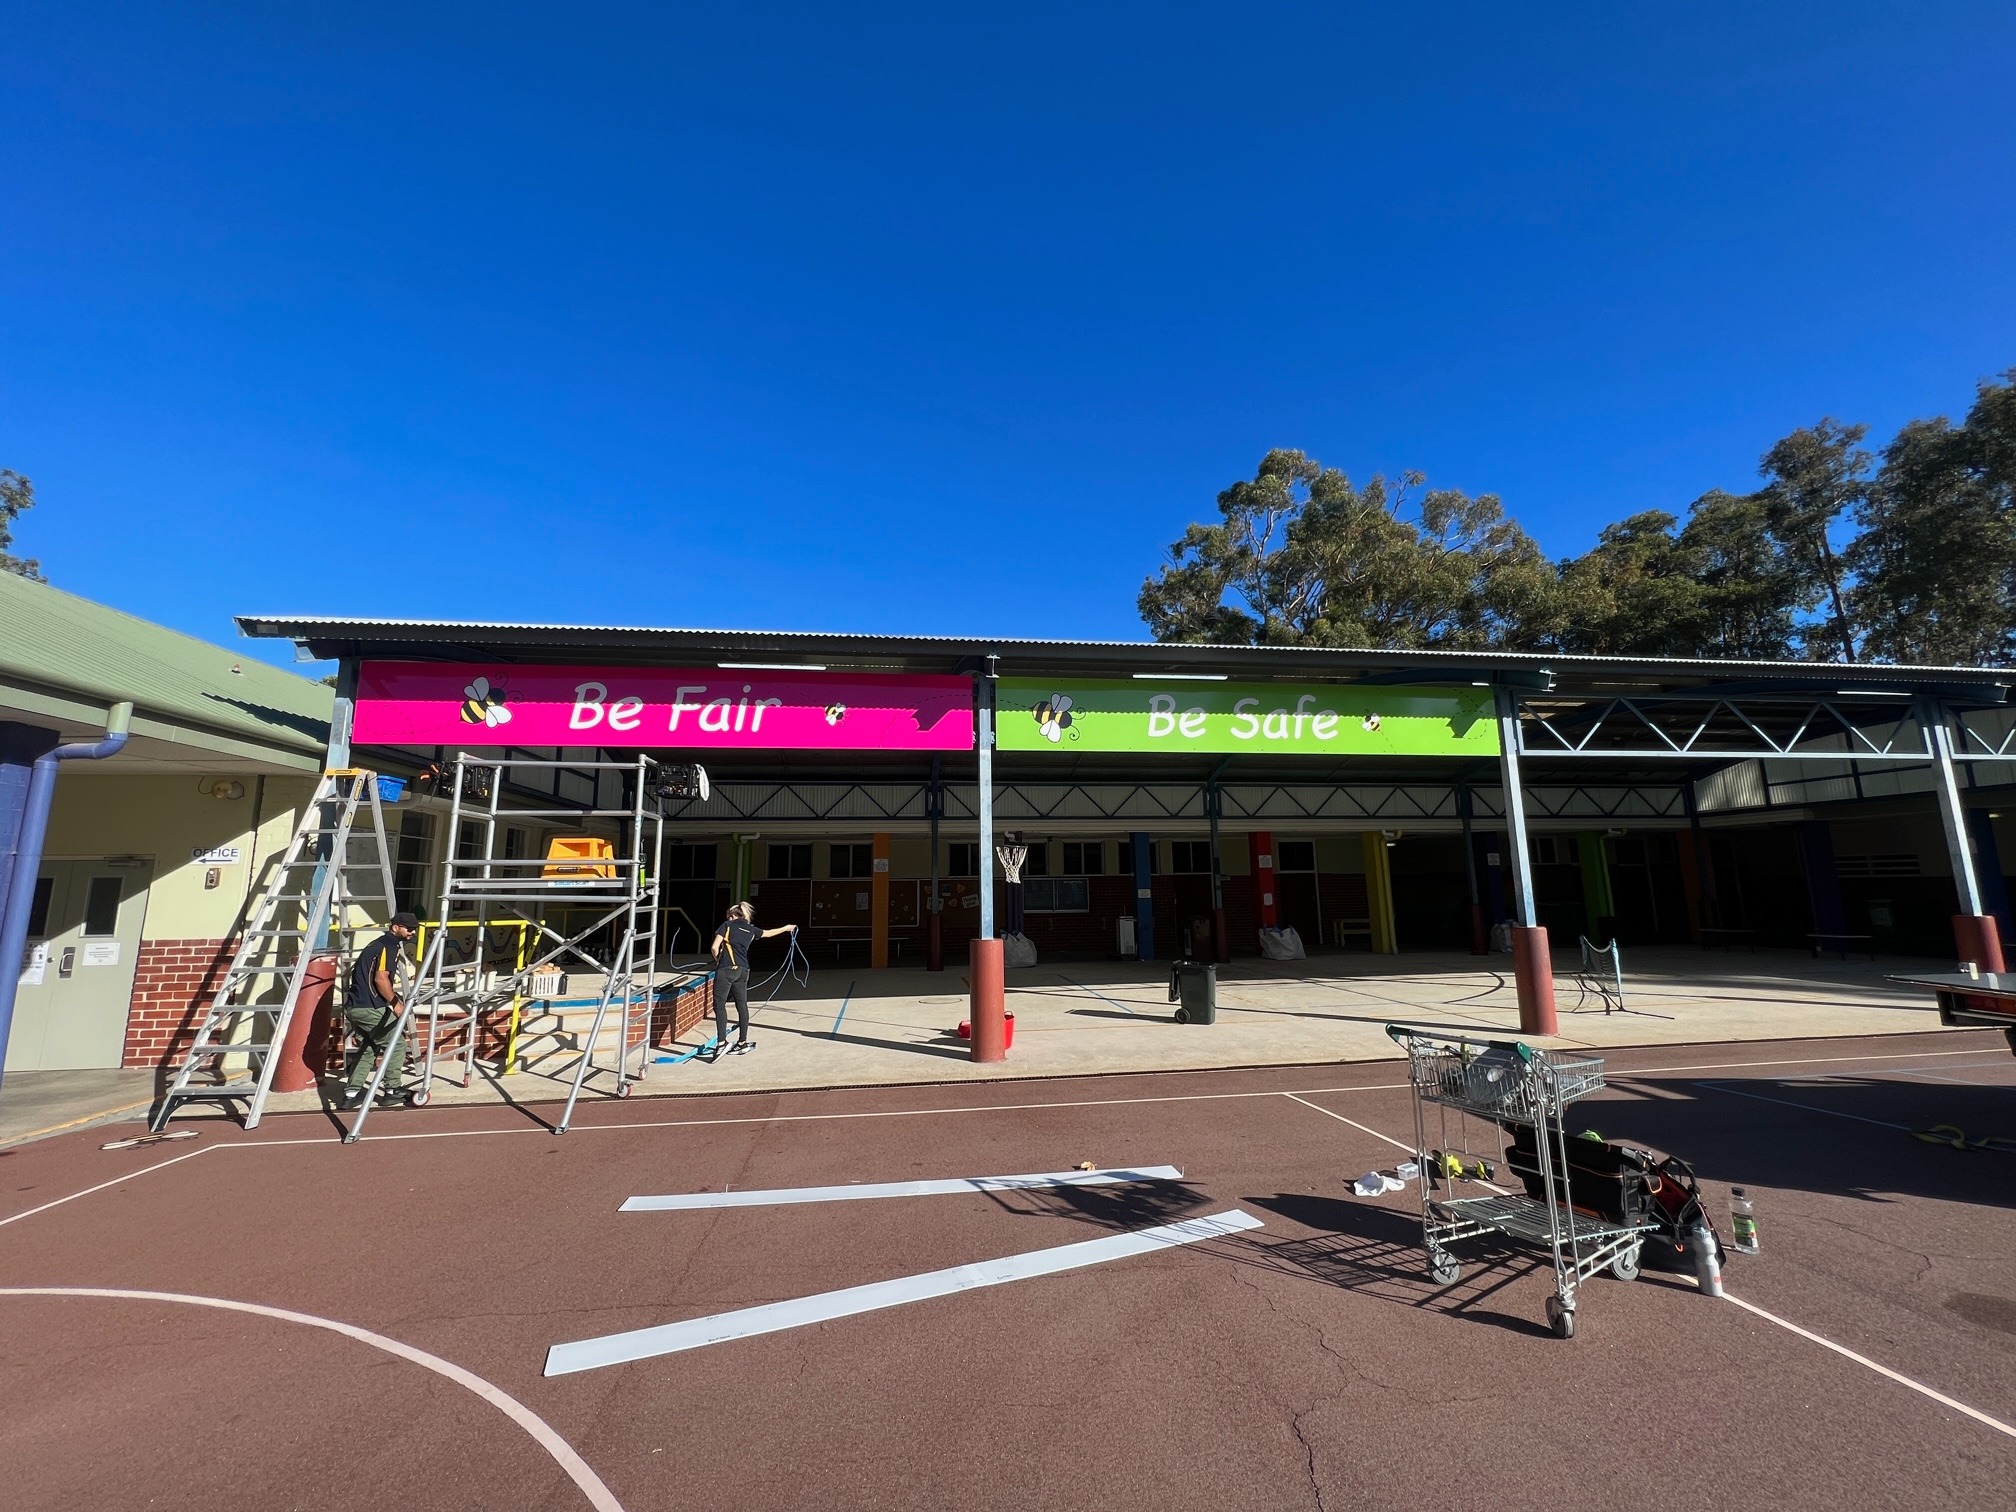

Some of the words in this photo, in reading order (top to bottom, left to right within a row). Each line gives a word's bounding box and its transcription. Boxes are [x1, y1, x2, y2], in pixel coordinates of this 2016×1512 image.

[569, 681, 644, 731] Be
[668, 684, 783, 733] Fair
[1147, 694, 1207, 739] Be
[1230, 694, 1339, 740] Safe
[193, 848, 239, 858] OFFICE
